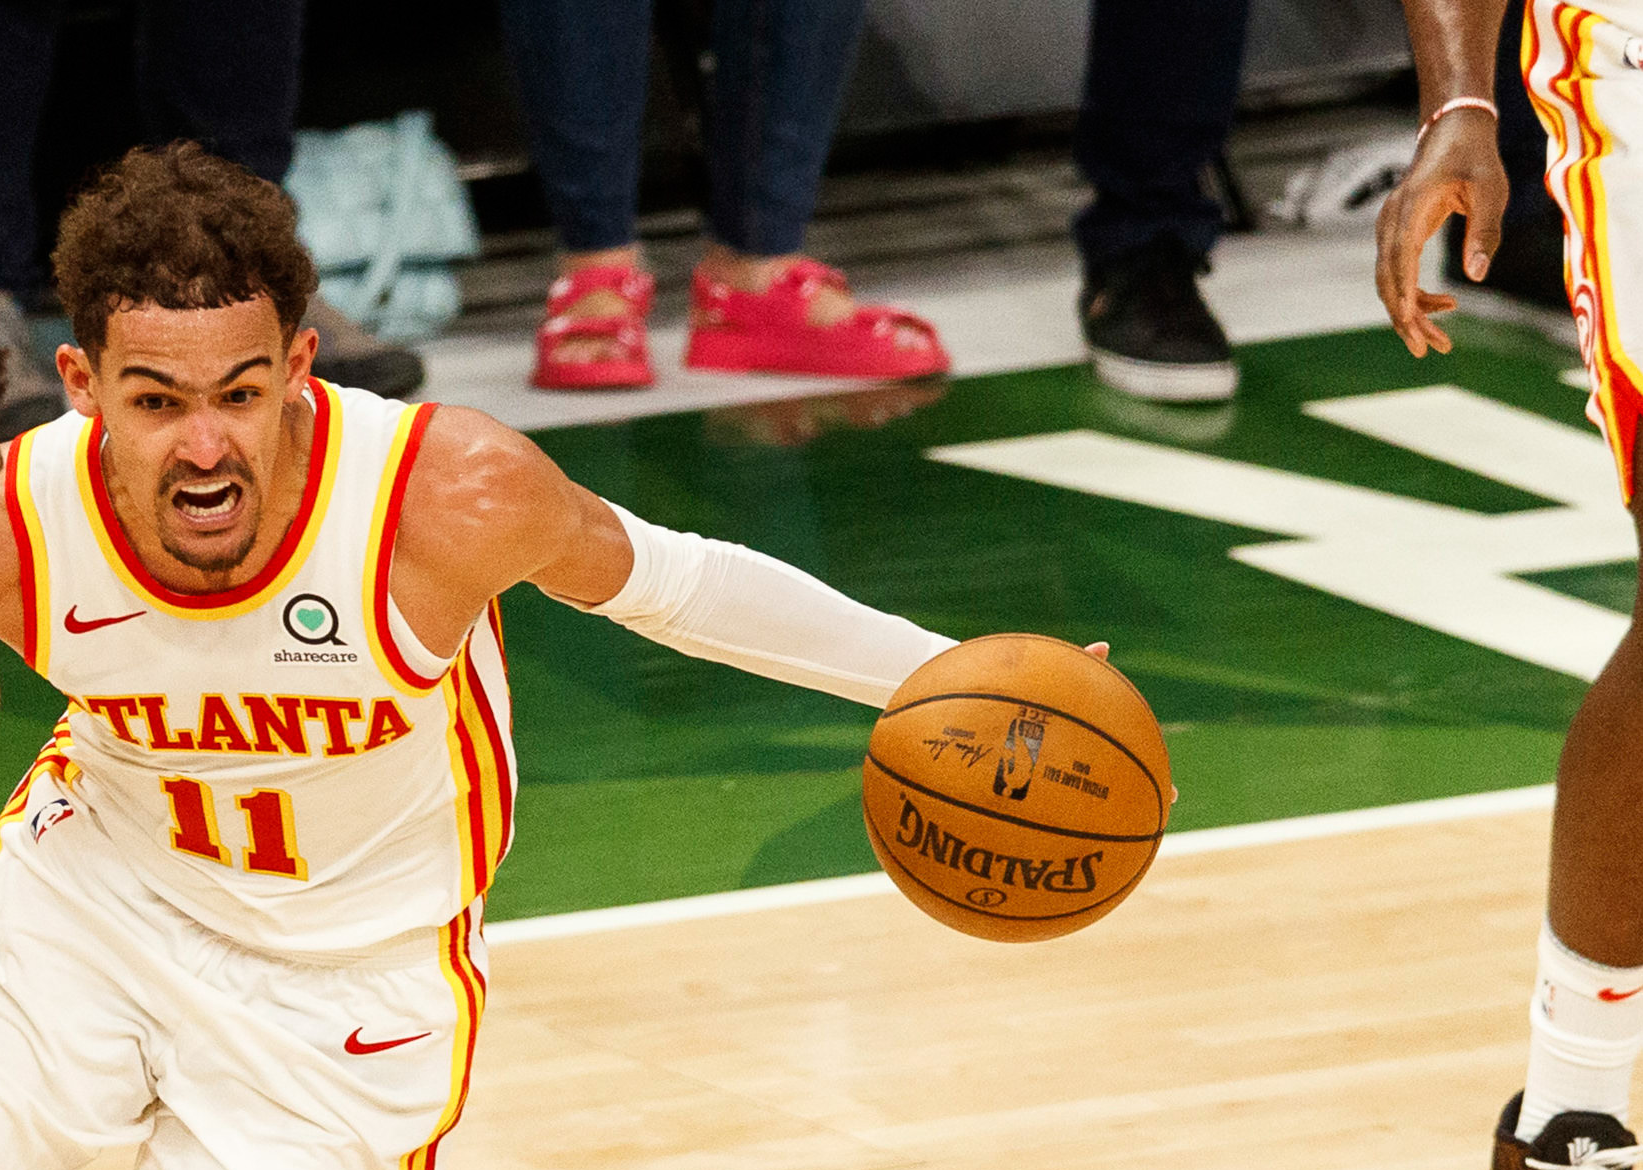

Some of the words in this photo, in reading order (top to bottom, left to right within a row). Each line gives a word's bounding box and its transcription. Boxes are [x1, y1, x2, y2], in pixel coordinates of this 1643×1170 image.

[273, 648, 358, 663] sharecare
[82, 691, 414, 758] TLANTA
[158, 773, 309, 882] 11
[895, 797, 1104, 893] SPALDING
